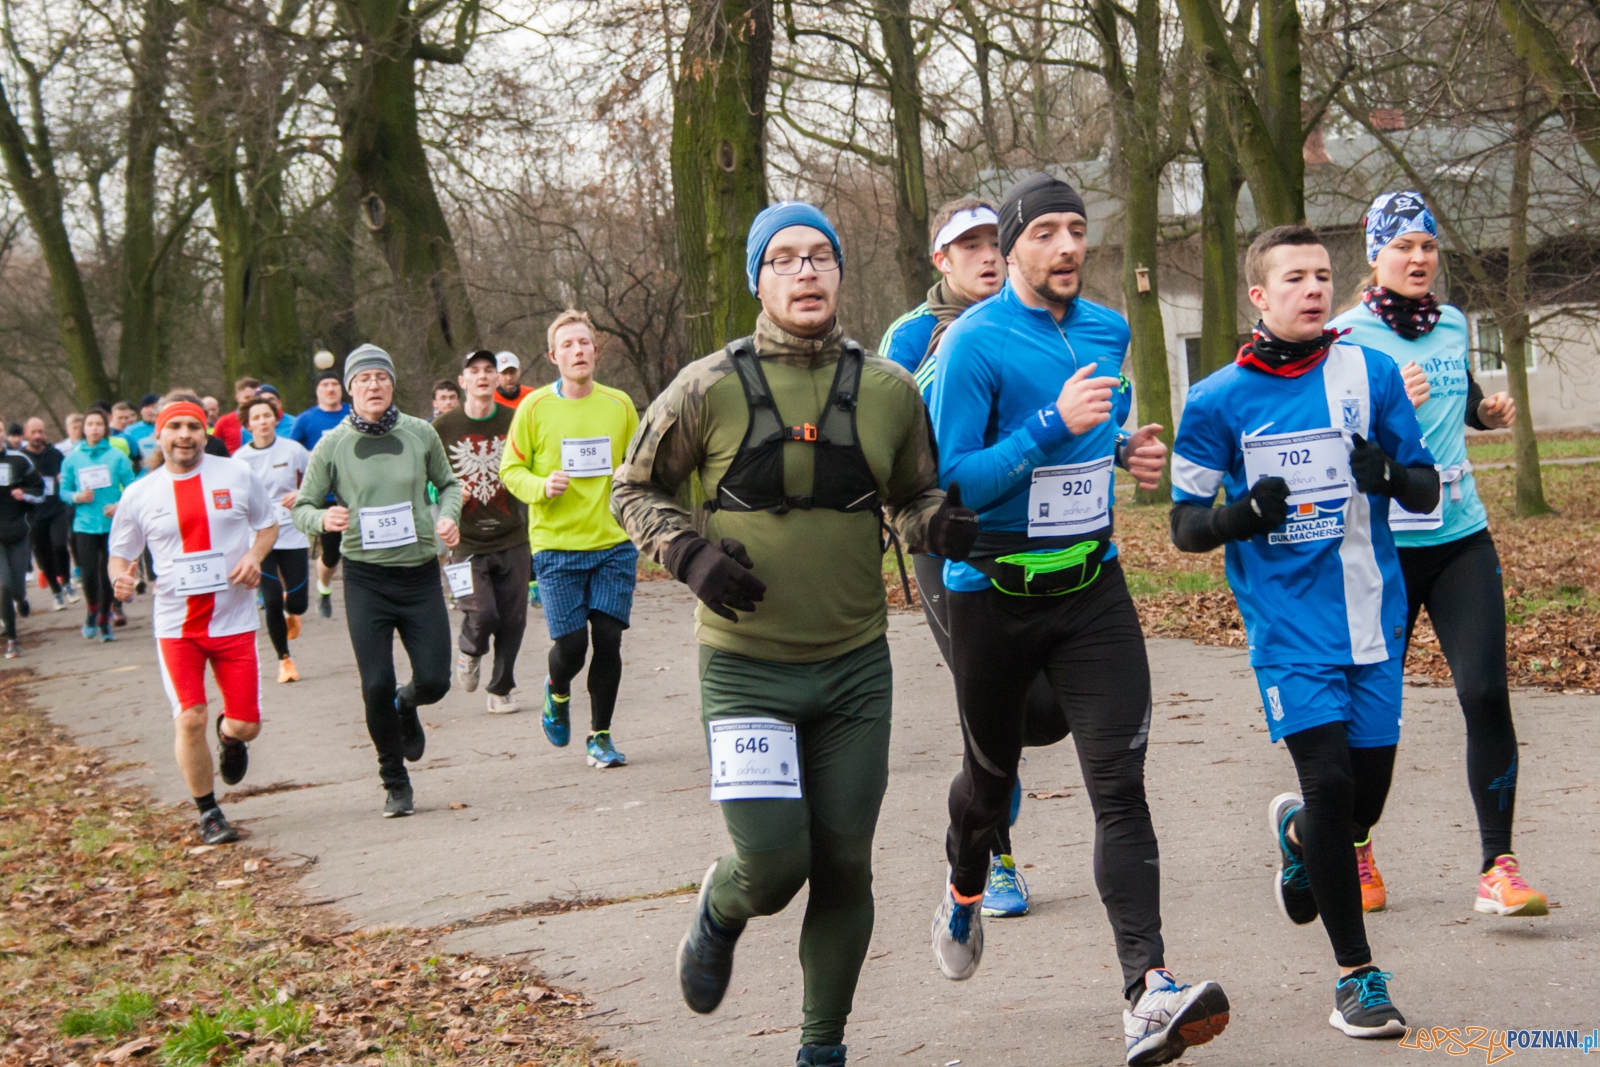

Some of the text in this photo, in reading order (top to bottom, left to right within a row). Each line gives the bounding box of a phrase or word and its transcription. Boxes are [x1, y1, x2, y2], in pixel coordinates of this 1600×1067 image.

[580, 447, 597, 457] 958
[1278, 449, 1312, 467] 702
[1062, 479, 1092, 496] 920
[1063, 501, 1092, 517] parkrun
[378, 517, 397, 528] 553
[1288, 519, 1336, 533] ZAKŁADY
[190, 563, 208, 574] 335
[735, 737, 769, 754] 646
